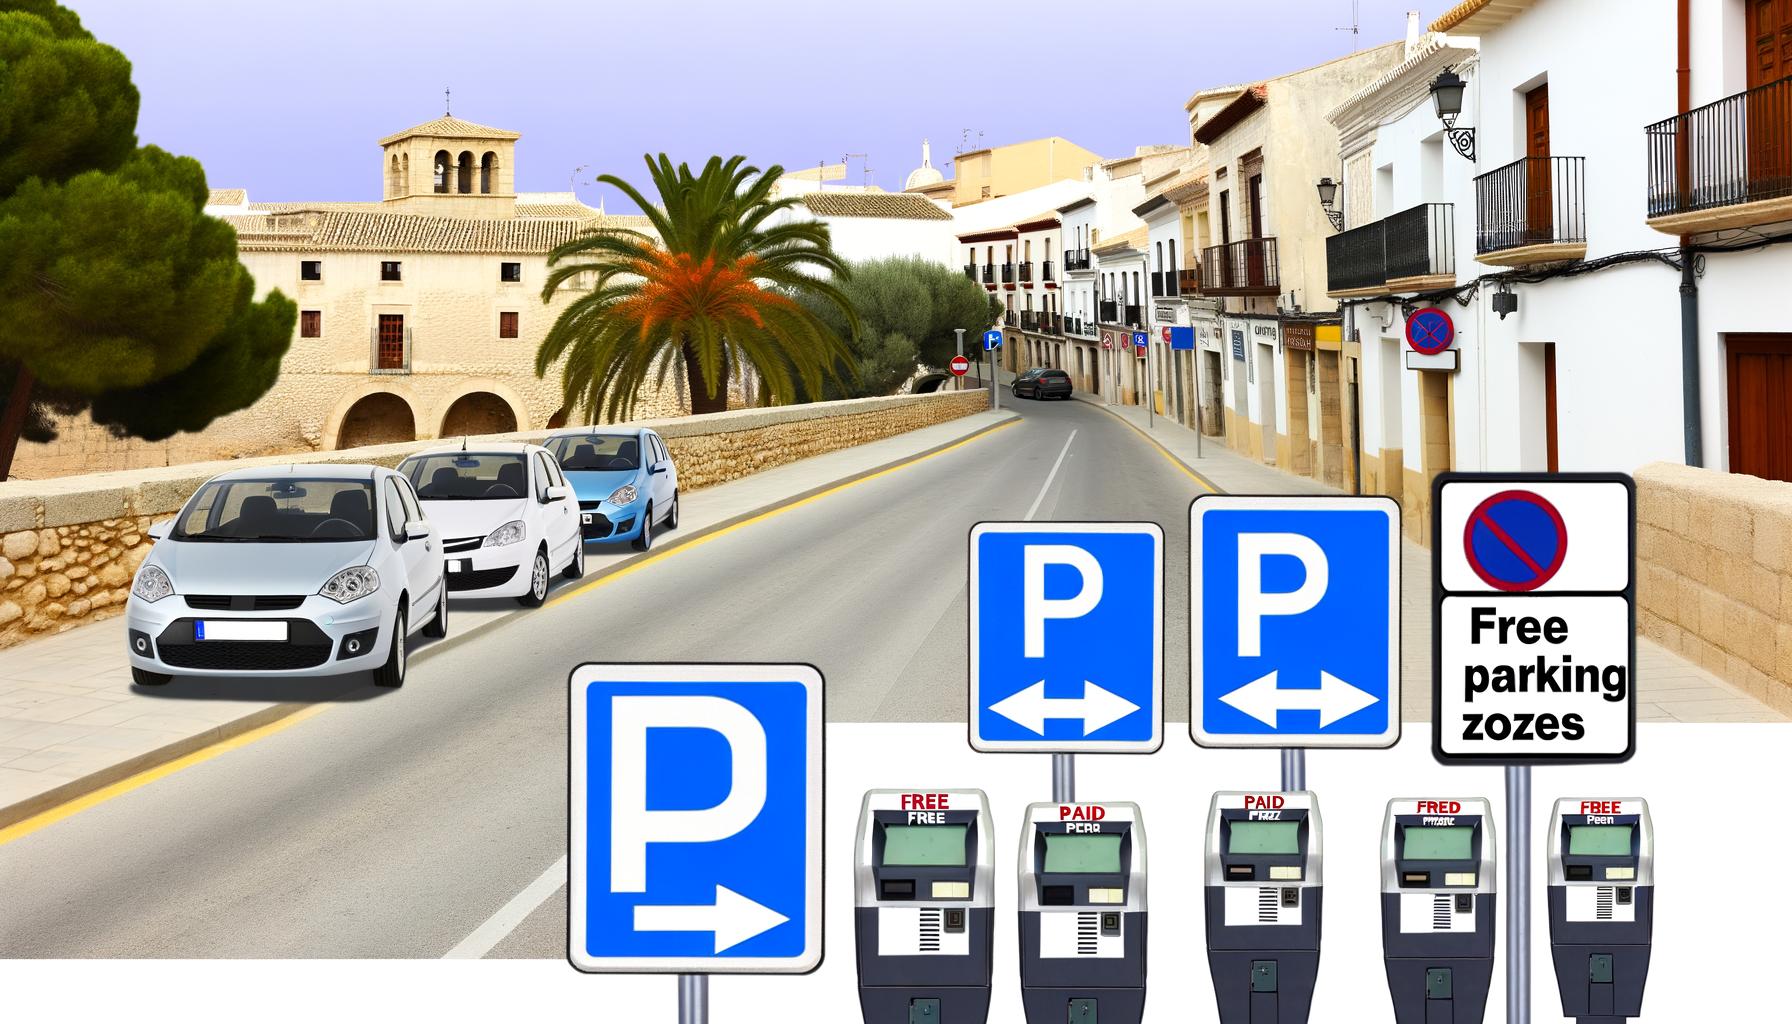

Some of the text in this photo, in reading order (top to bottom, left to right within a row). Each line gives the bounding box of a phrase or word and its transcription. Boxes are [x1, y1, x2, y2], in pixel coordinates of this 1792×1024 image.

[1024, 545, 1104, 658] P
[1237, 532, 1328, 657] P
[1471, 607, 1568, 644] Free
[1464, 655, 1626, 702] parking
[1462, 713, 1585, 741] zozes
[611, 696, 767, 893] P
[901, 794, 949, 810] FREE
[1244, 795, 1285, 809] PAID
[1417, 801, 1461, 814] FRED
[908, 812, 945, 826] FREE
[1060, 806, 1105, 821] PAID
